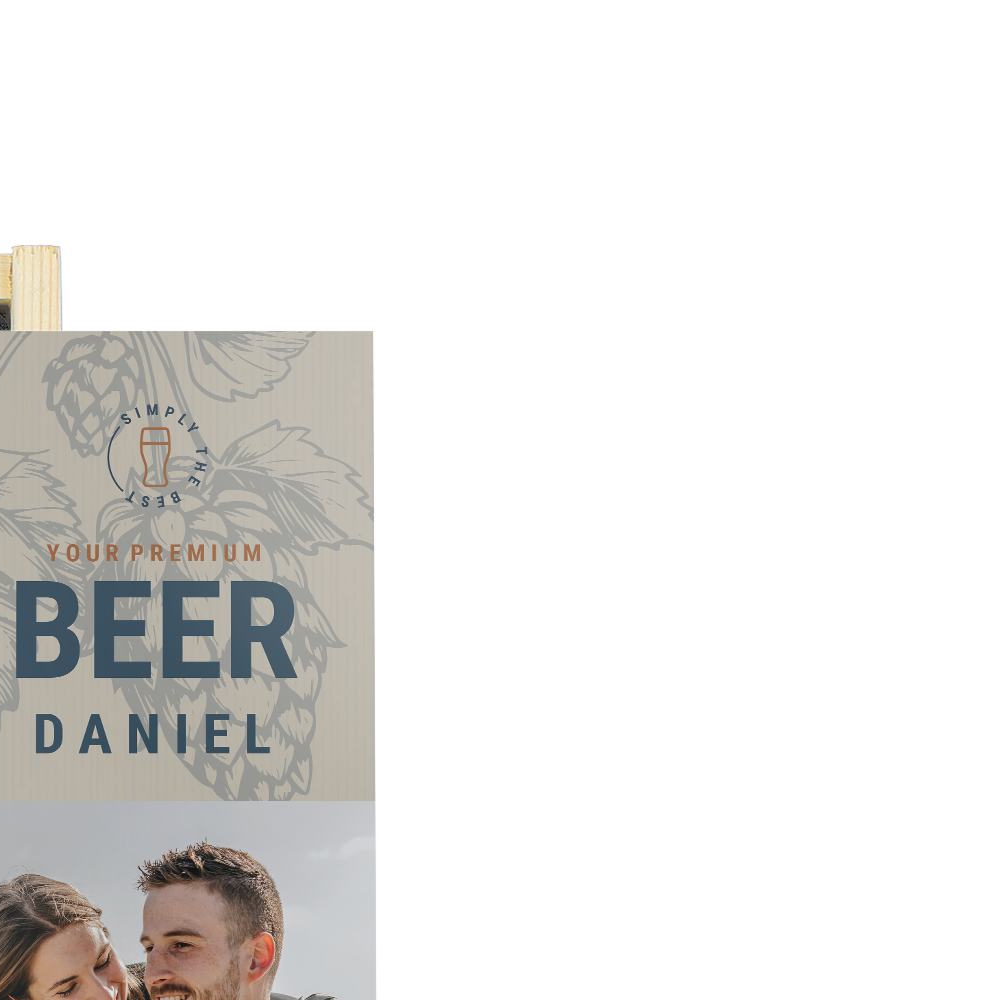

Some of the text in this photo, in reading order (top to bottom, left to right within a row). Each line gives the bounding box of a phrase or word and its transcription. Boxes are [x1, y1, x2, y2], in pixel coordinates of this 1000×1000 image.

[120, 403, 209, 509] SIMPLY THE BEST
[47, 543, 262, 563] YOUR PREMIUM
[15, 580, 299, 679] BEER
[35, 713, 271, 755] DANIEL
